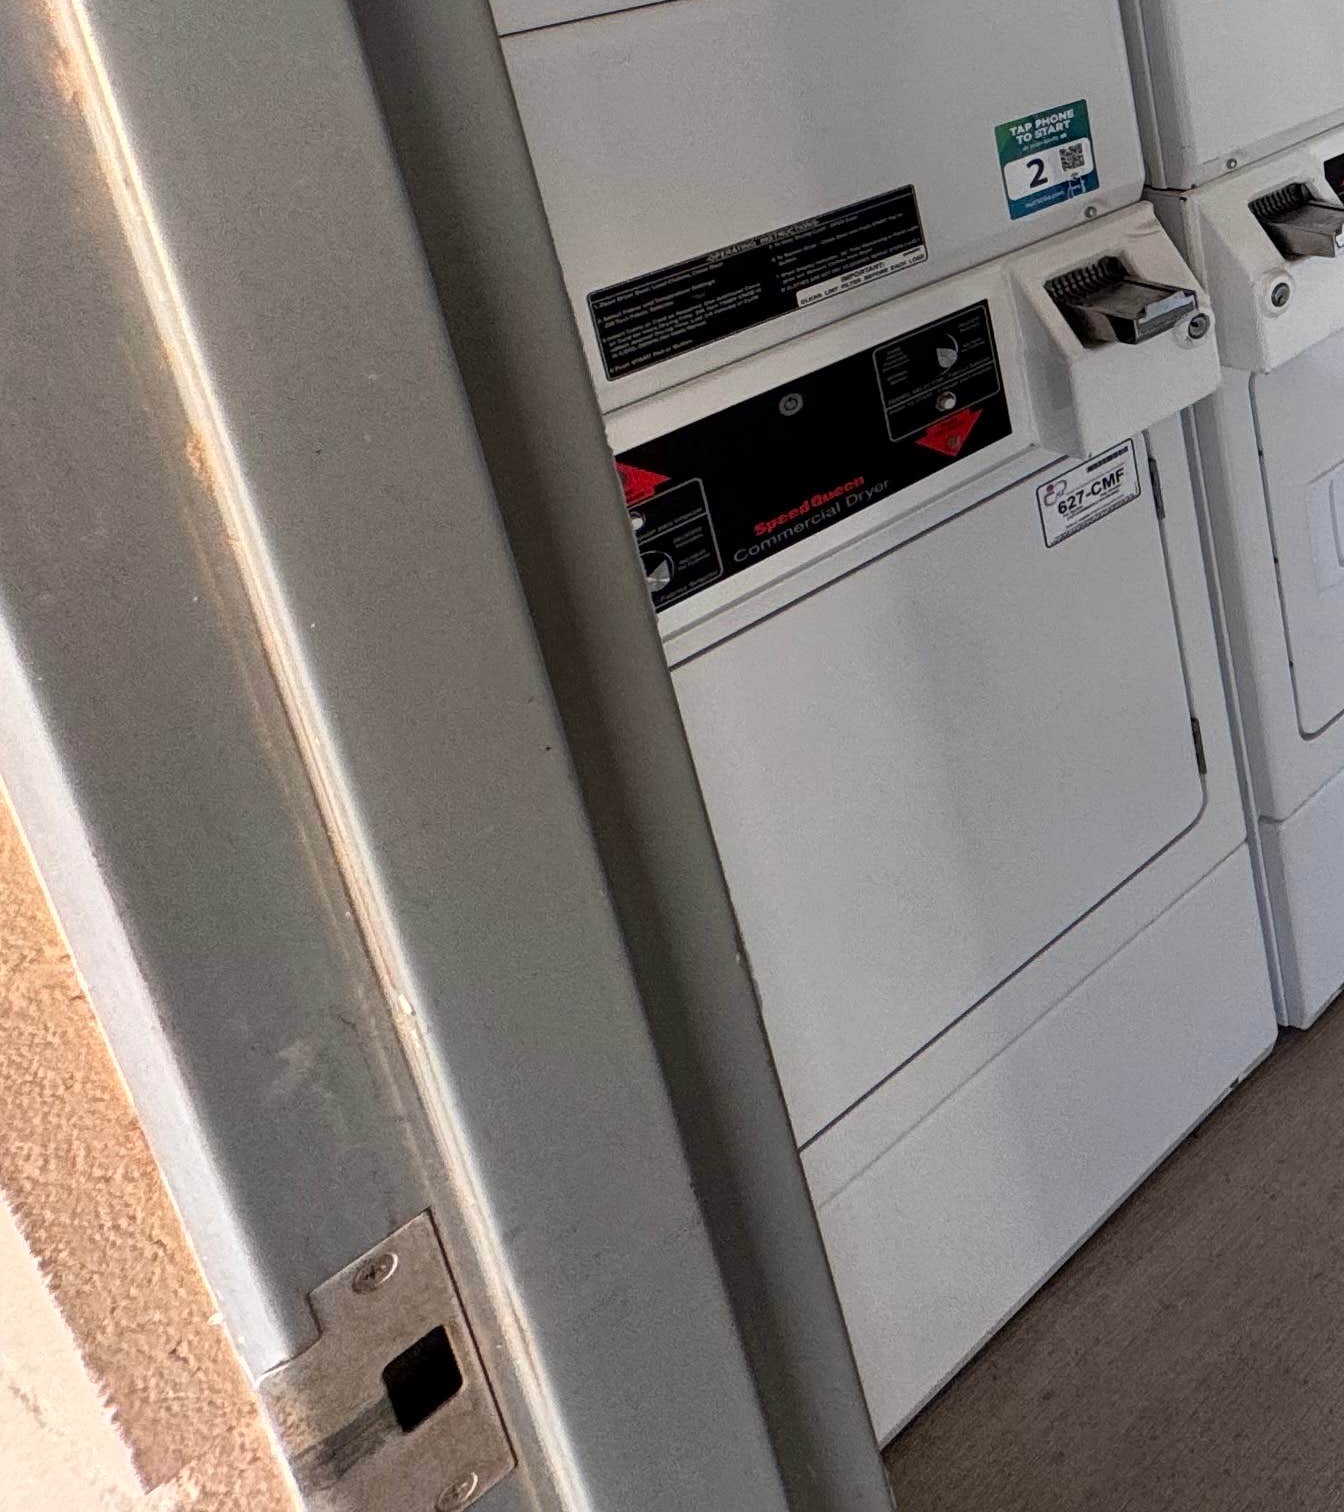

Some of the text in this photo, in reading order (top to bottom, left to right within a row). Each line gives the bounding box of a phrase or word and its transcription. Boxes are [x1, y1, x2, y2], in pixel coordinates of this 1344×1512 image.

[1009, 109, 1074, 136] TAP PHONE
[1016, 120, 1071, 144] TO START
[1026, 158, 1048, 188] 2
[753, 476, 866, 537] Speed Queen
[1058, 467, 1125, 514] 627-CMF
[733, 478, 890, 563] Commercial Dryer
